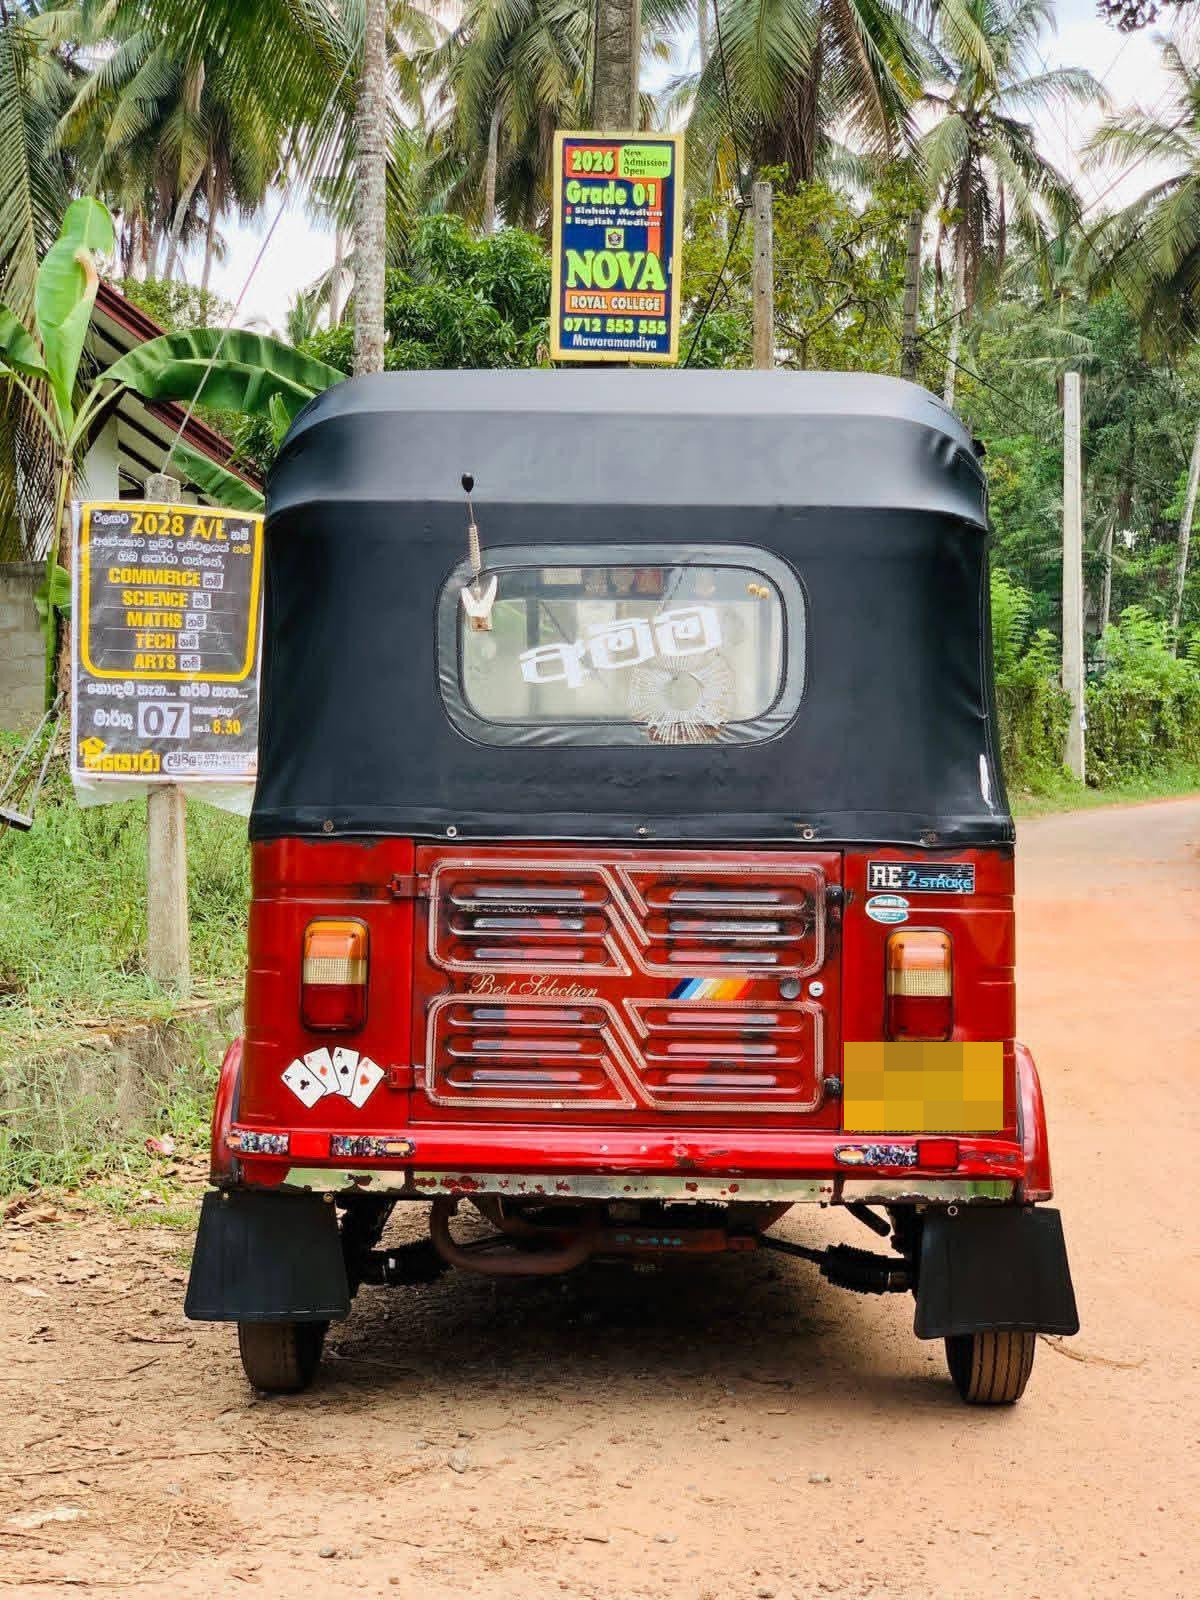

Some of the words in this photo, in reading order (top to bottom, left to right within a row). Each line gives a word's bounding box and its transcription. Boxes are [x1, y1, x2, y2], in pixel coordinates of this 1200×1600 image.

[572, 150, 614, 173] 2026
[623, 148, 641, 157] New
[623, 157, 668, 168] Admission
[623, 167, 646, 176] Open
[566, 180, 627, 206] Grade
[632, 183, 656, 206] 01
[574, 206, 616, 216] Sinhala
[618, 208, 663, 217] Medium
[574, 216, 614, 226] English
[616, 218, 661, 227] Medium
[565, 249, 667, 291] NOVA
[571, 295, 608, 310] ROYAL
[611, 296, 661, 311] COLLEGE
[563, 317, 602, 333] 0712
[605, 318, 634, 334] 553
[638, 320, 667, 335] 555
[572, 333, 658, 351] Mawaramandiya
[130, 512, 185, 538] 2028
[189, 517, 229, 542] A/L
[107, 567, 201, 587] COMMERCE
[121, 590, 189, 608] SCIENCE
[126, 611, 183, 629] MATHS
[135, 633, 176, 649] TECH
[133, 653, 177, 670] ARTS
[143, 705, 185, 737] 07
[871, 865, 903, 888] RE
[918, 877, 972, 889] STROKE
[468, 973, 517, 996] Best
[519, 974, 599, 998] Selection
